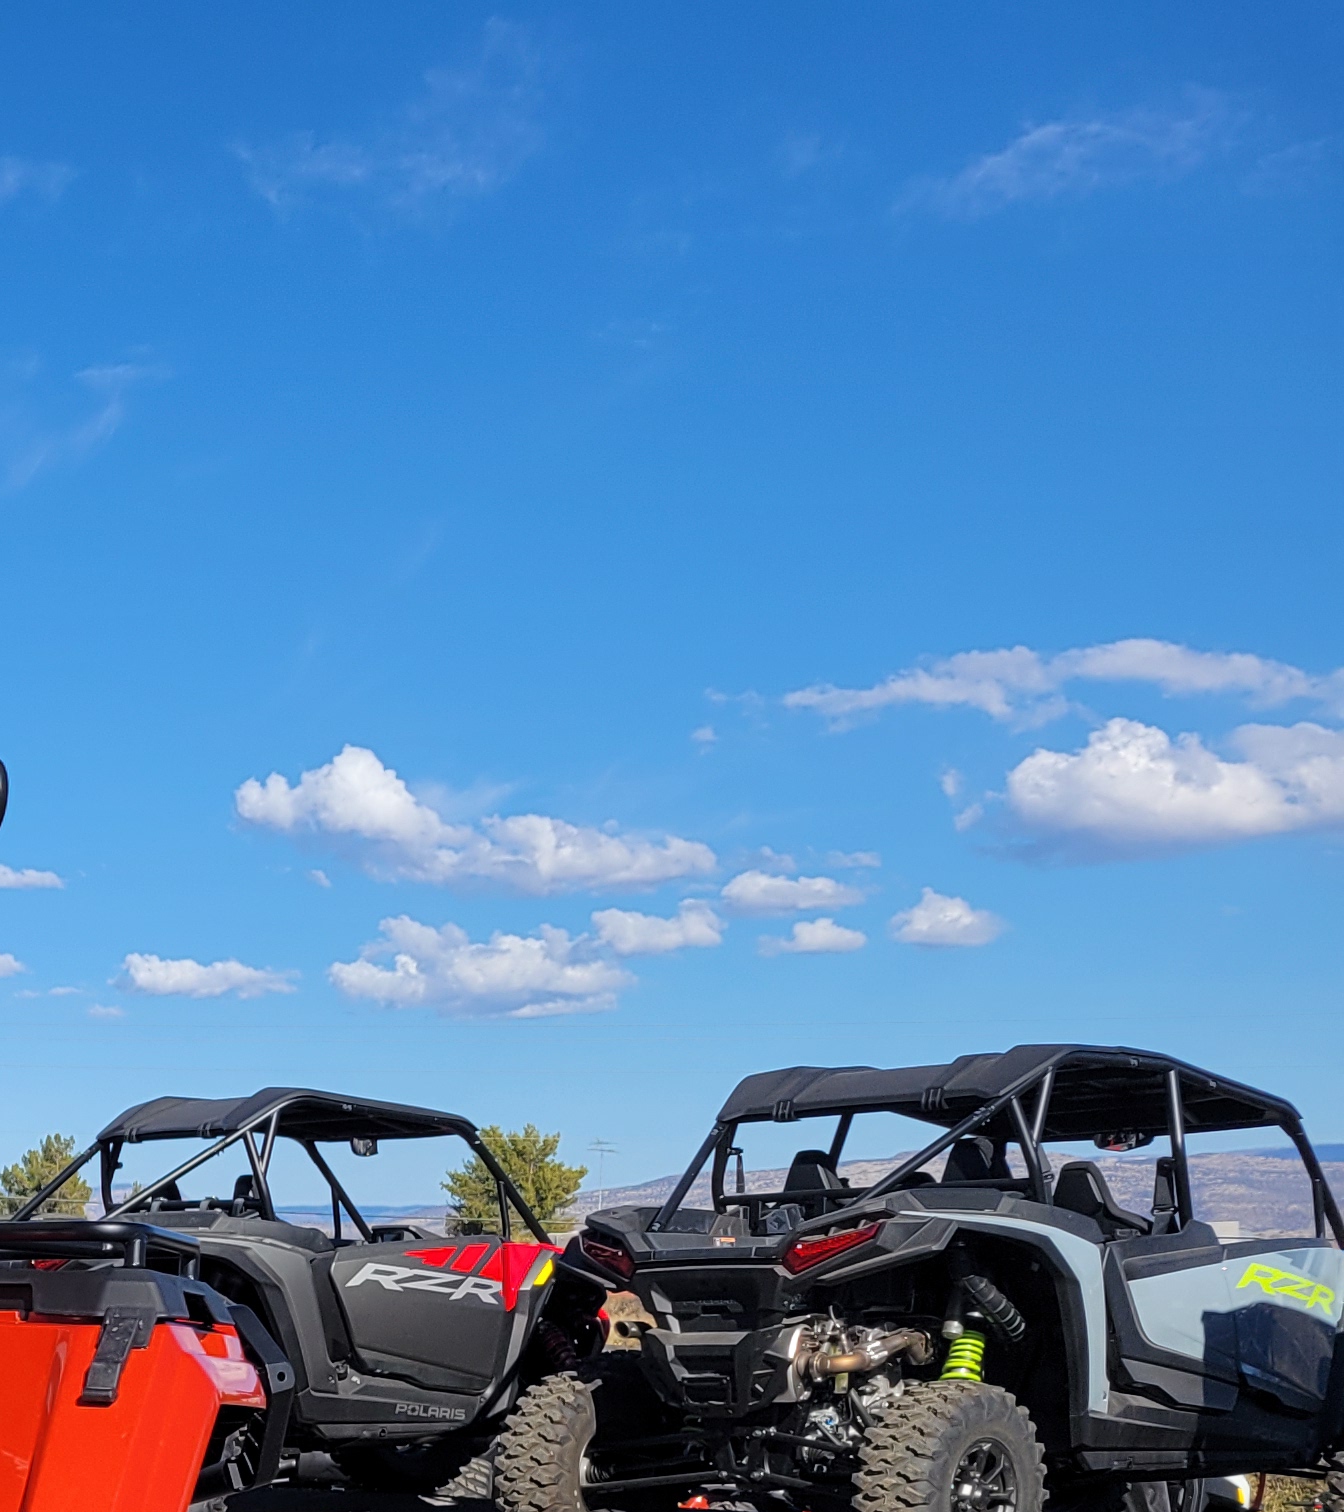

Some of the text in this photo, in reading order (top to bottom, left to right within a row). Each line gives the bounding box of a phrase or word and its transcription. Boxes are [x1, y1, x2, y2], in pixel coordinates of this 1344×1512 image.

[345, 1262, 503, 1305] RZR
[1235, 1262, 1336, 1315] RZR
[395, 1403, 466, 1420] POLARIS
